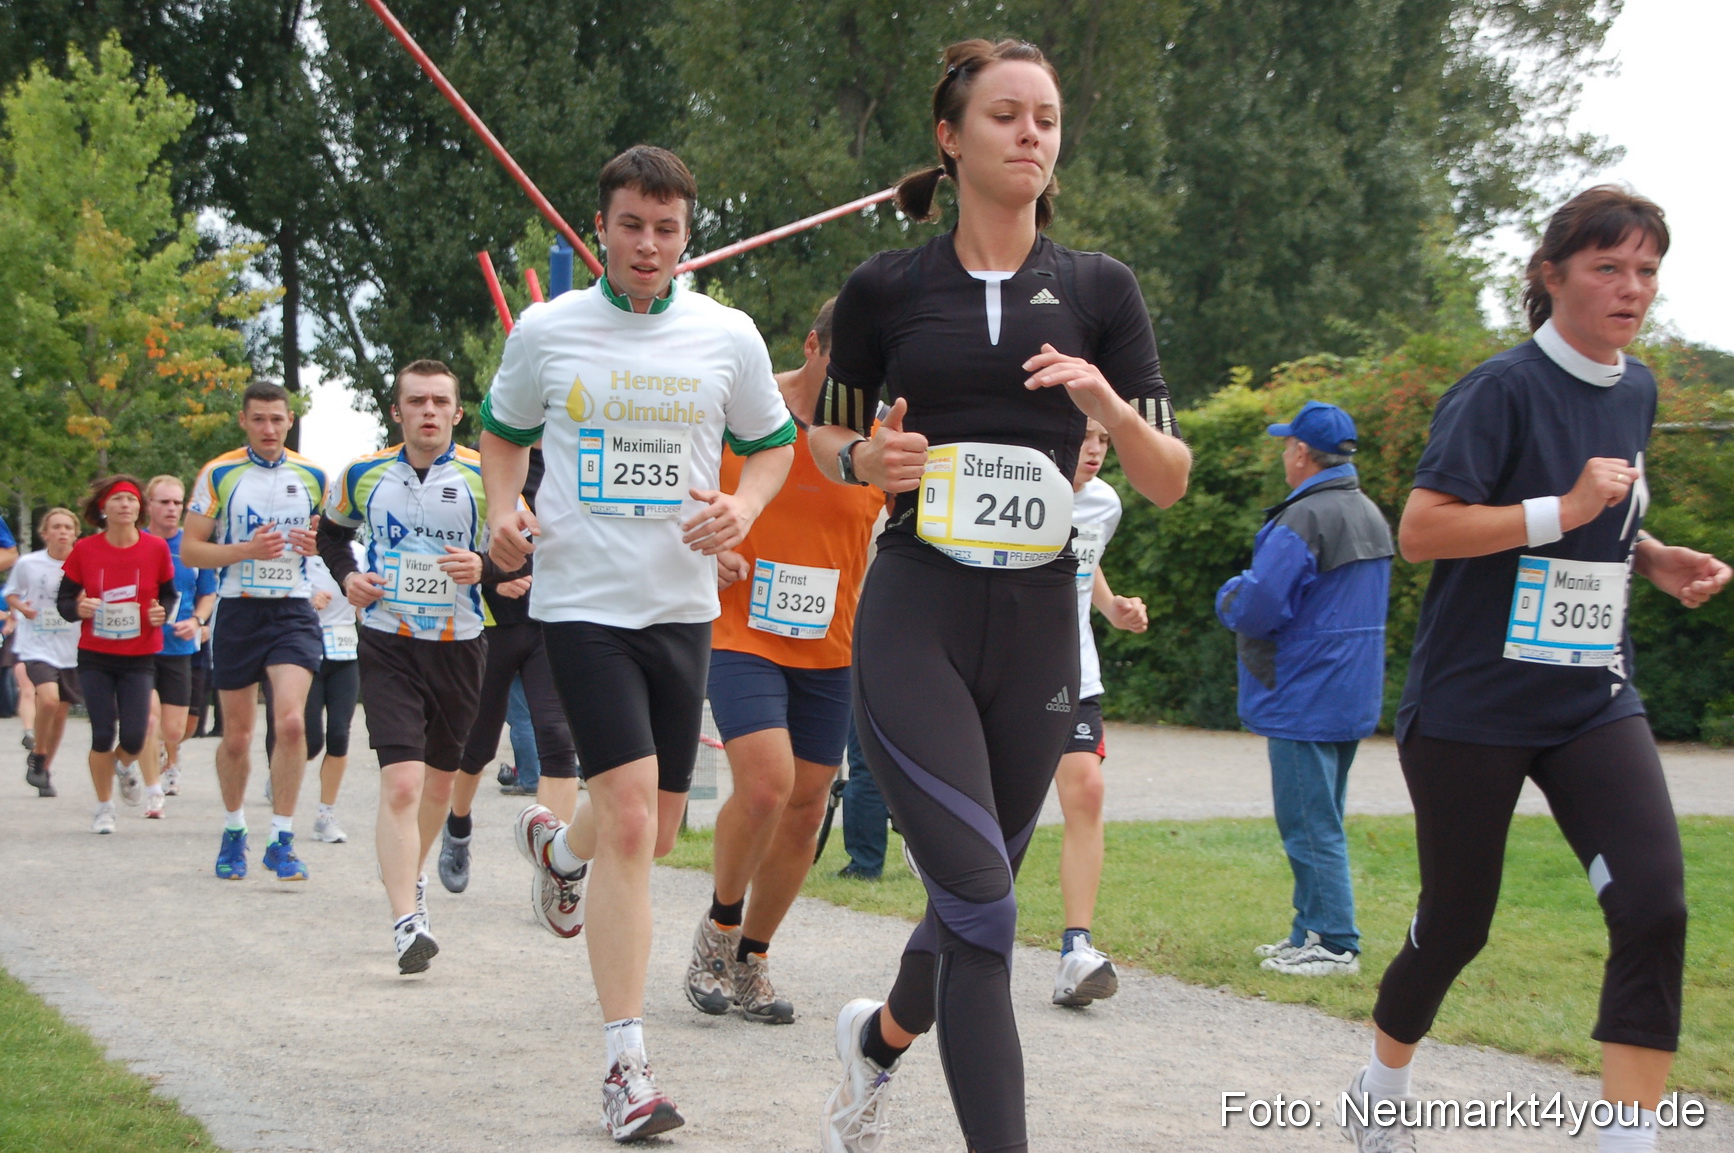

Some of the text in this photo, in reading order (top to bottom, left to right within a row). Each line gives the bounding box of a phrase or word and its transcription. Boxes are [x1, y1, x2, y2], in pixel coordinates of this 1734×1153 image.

[611, 370, 701, 396] Henger
[603, 396, 705, 424] Ölmühle
[613, 436, 681, 453] Maximilian
[587, 460, 594, 472] B
[964, 454, 1042, 482] Stefanie
[613, 463, 679, 487] 2535
[926, 487, 935, 503] D
[974, 493, 1046, 530] 240
[416, 527, 465, 542] PLAST
[259, 567, 292, 580] 3223
[405, 558, 433, 572] Viktor
[405, 576, 448, 595] 3221
[779, 570, 807, 586] Ernst
[1554, 570, 1601, 591] Monika
[757, 585, 764, 596] B
[776, 592, 826, 614] 3329
[107, 615, 136, 627] 2653
[1551, 601, 1612, 629] 3036
[1046, 702, 1071, 712] adidas
